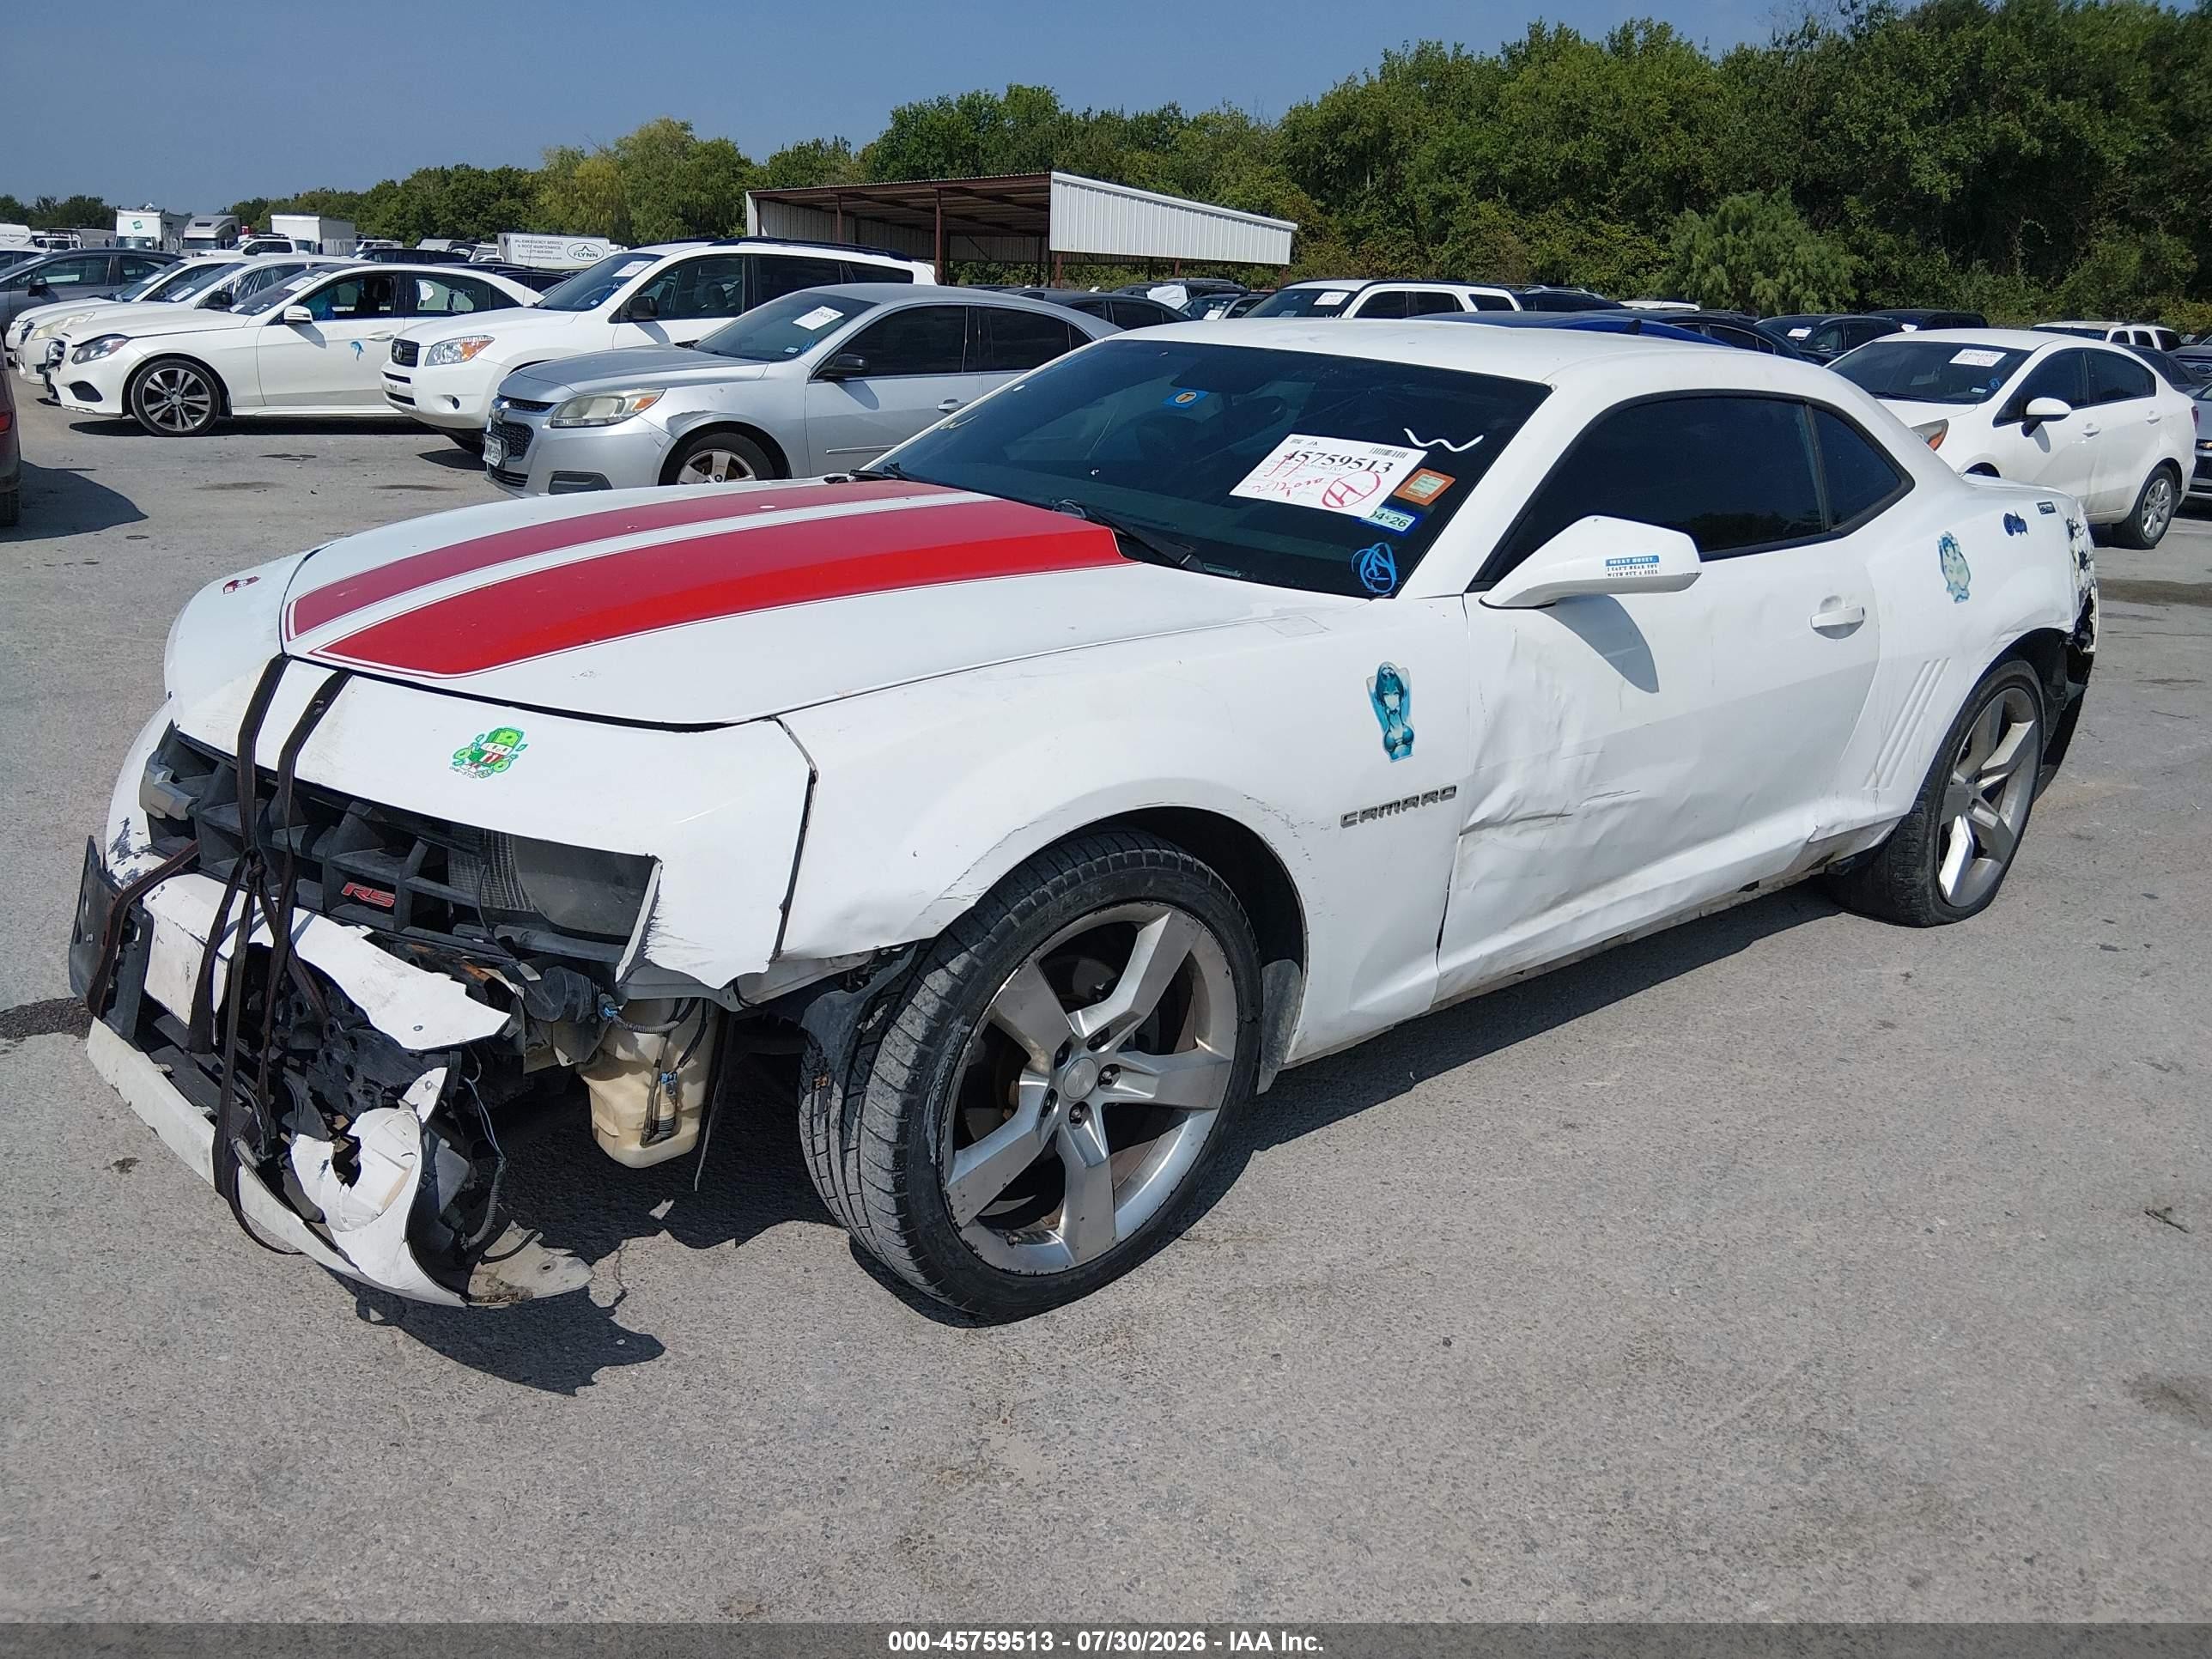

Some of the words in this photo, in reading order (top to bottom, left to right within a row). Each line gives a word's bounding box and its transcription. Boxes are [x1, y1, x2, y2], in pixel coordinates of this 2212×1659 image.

[1283, 449, 1395, 474] 45759513
[1340, 784, 1457, 830] CAMARO
[341, 881, 396, 908] RS
